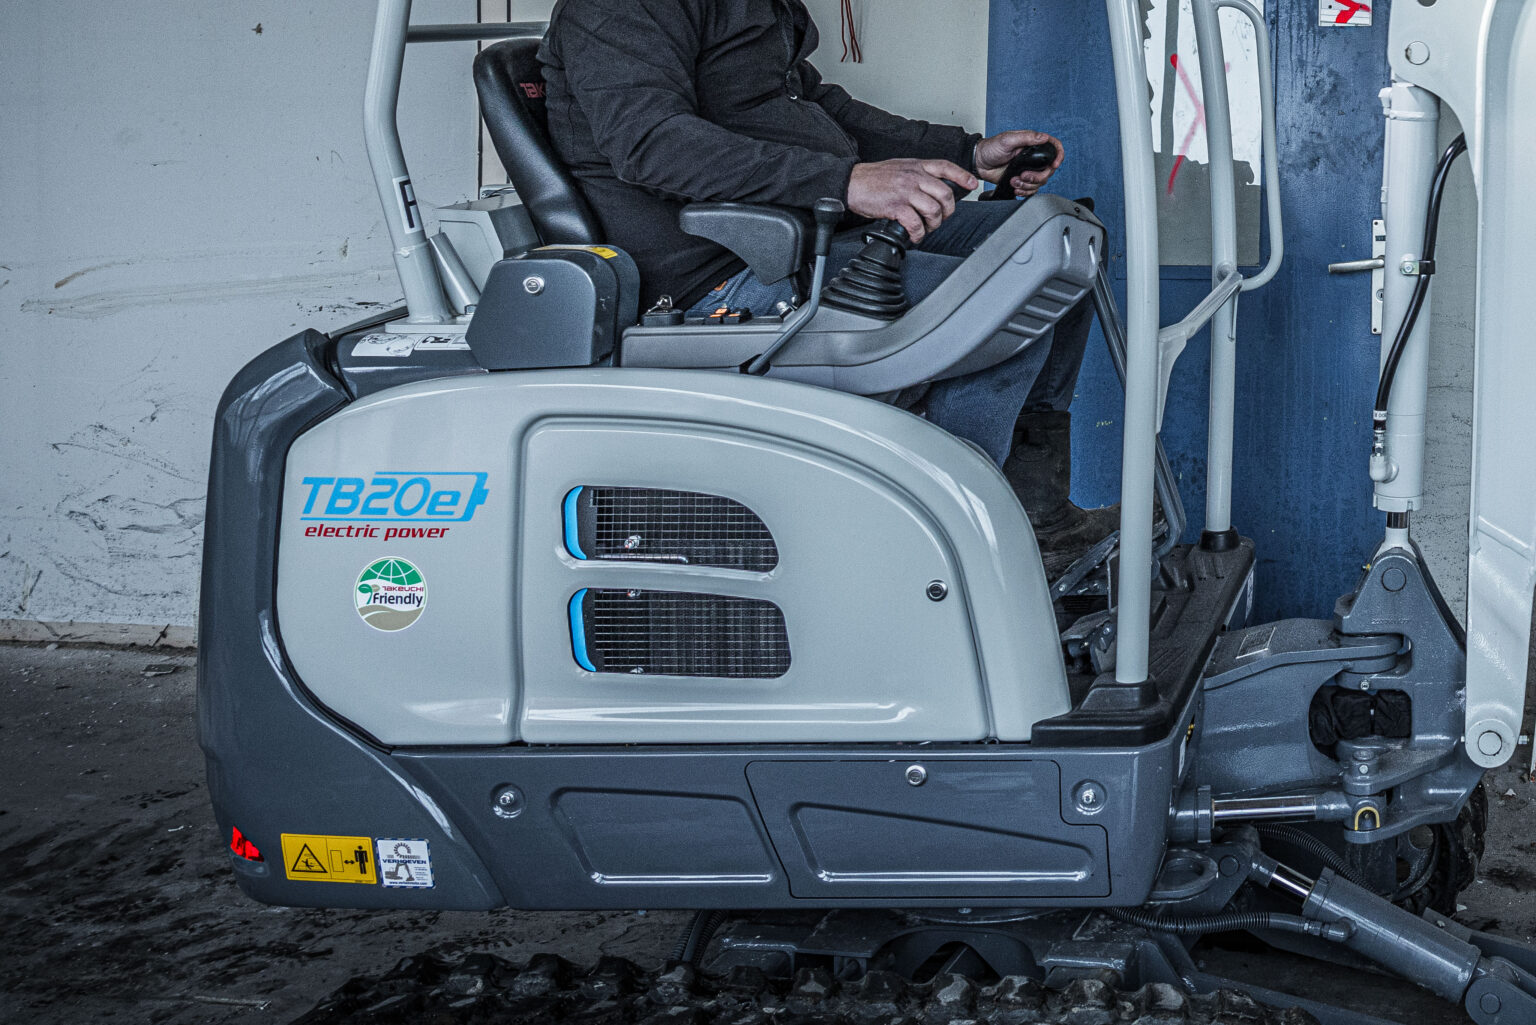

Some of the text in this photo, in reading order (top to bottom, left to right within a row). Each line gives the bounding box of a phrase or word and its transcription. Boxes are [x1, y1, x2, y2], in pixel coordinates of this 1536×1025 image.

[301, 476, 462, 517] TB20e
[304, 523, 450, 542] electric power
[372, 592, 424, 608] Friendly
